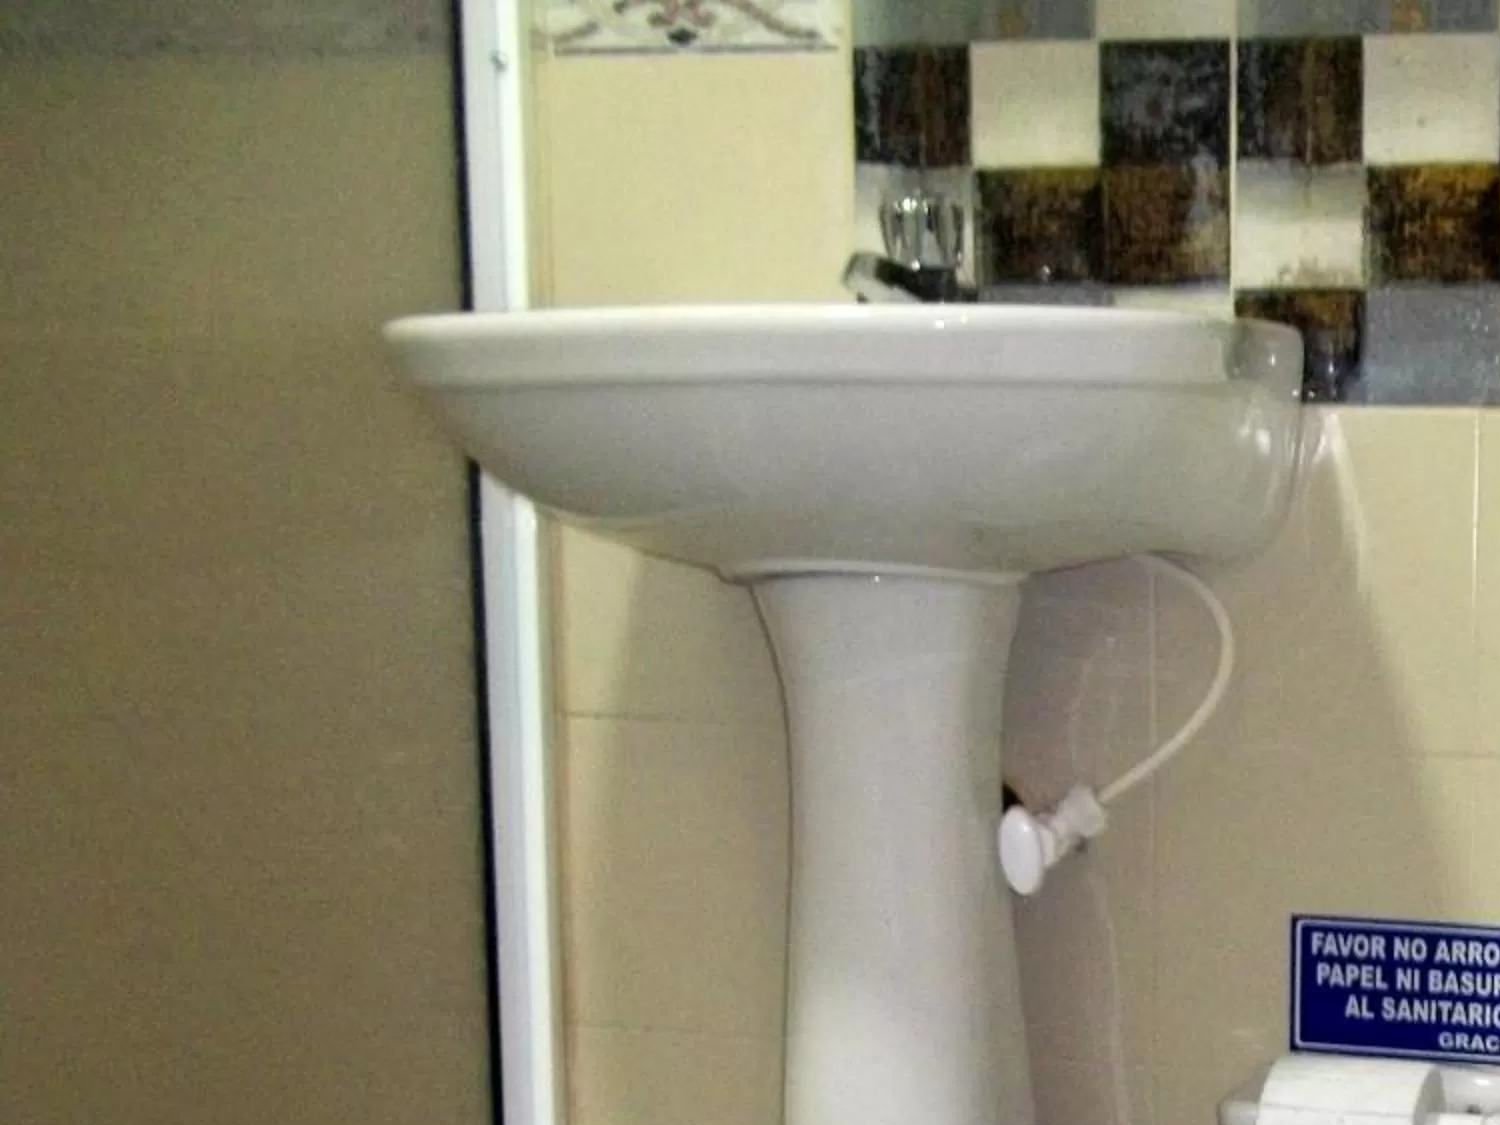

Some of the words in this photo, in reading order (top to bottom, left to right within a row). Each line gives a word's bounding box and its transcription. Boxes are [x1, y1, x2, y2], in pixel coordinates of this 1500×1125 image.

[1311, 931, 1386, 960] FAVOR
[1394, 936, 1427, 963] NO
[1317, 962, 1388, 990] PAPEL
[1396, 967, 1420, 992] NI
[1345, 994, 1374, 1019] AL
